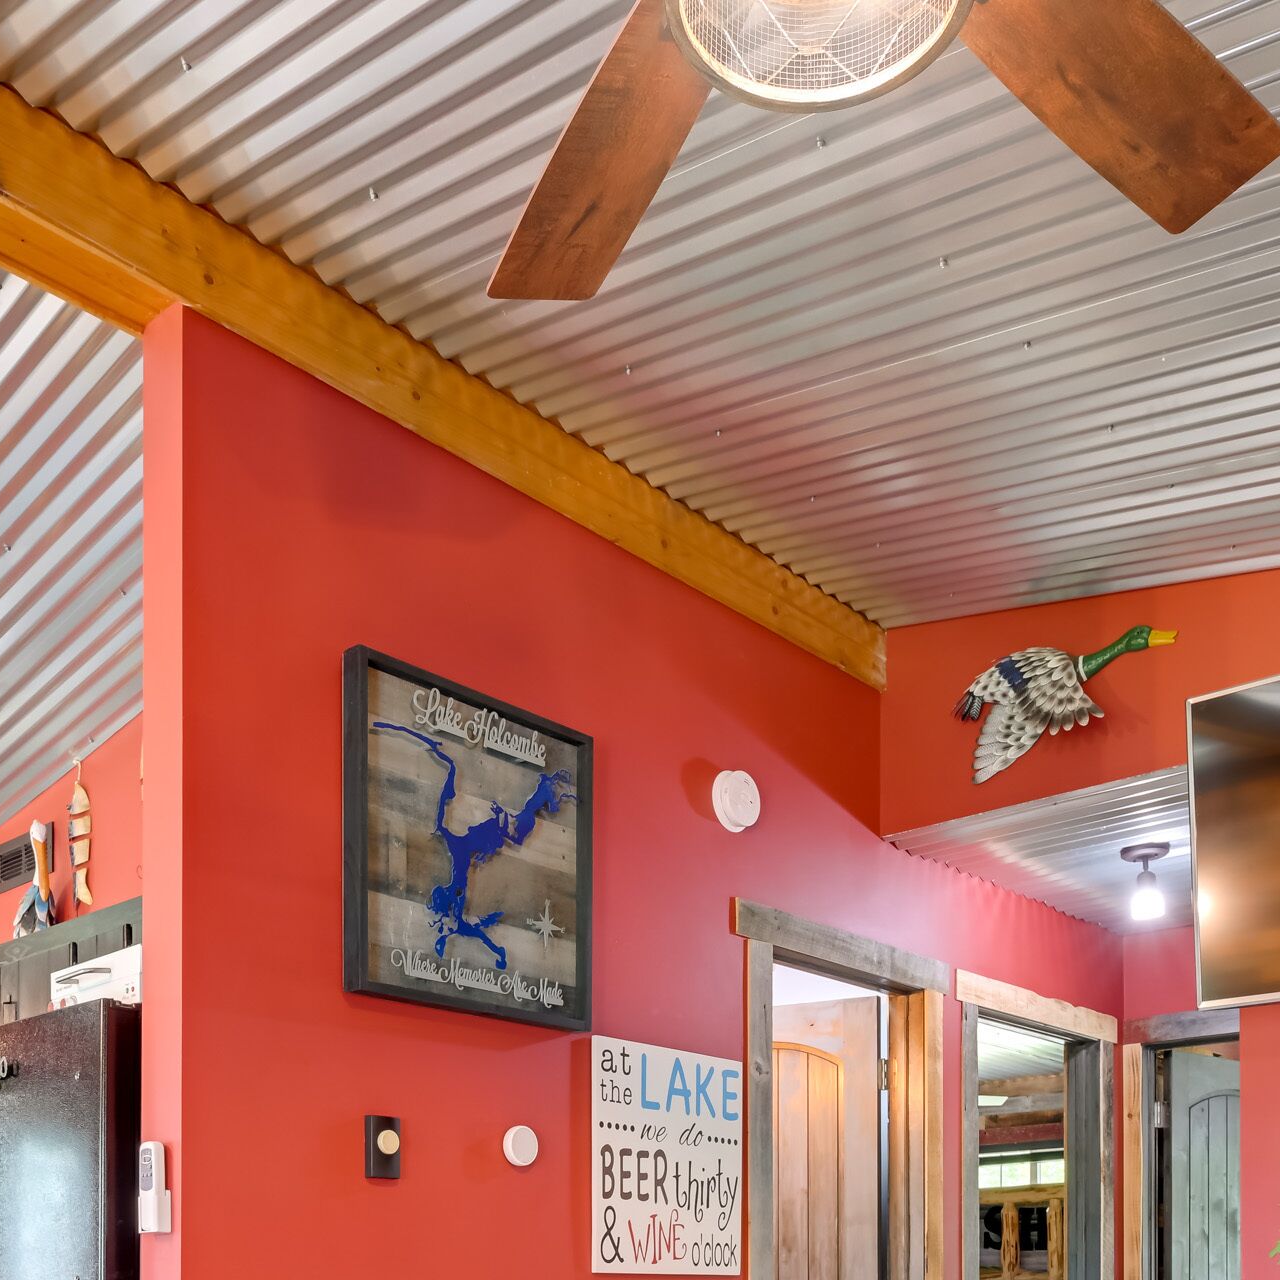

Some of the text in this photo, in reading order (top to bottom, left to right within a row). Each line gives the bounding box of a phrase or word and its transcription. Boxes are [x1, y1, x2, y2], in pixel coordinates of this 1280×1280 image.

[413, 688, 546, 762] Lake Holcombe
[390, 948, 564, 1008] Where Memories Are Made
[599, 1053, 740, 1121] the LAKE
[600, 1046, 632, 1076] at
[640, 1122, 705, 1147] we do
[600, 1143, 739, 1231] BEER thirty
[600, 1205, 738, 1268] & WINE o'clock
